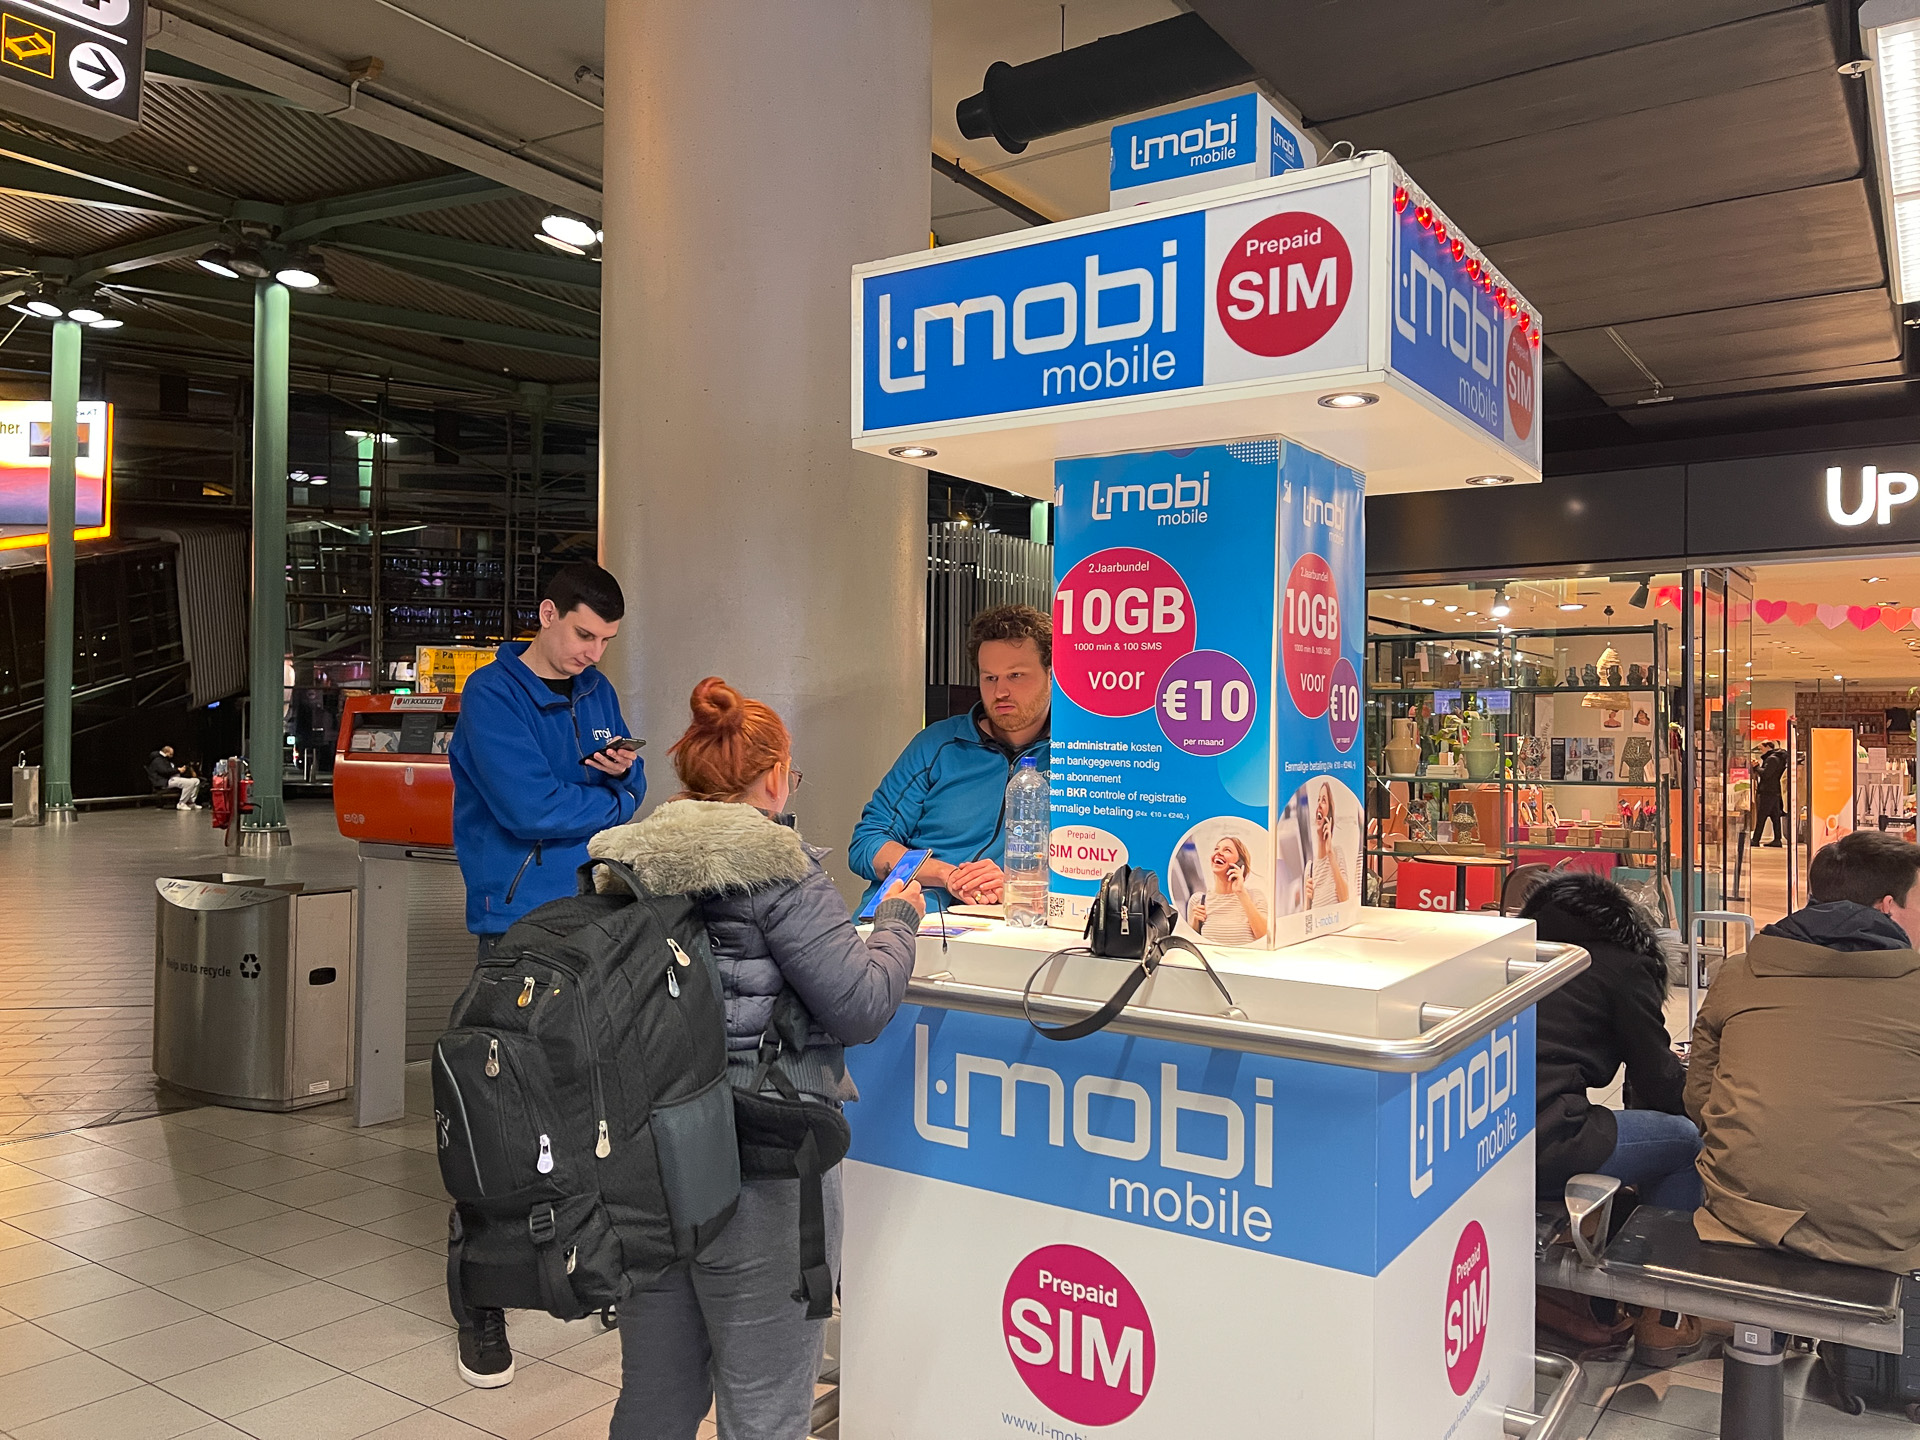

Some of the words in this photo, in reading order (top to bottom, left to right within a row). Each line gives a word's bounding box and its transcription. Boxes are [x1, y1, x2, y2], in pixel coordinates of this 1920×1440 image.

[1190, 147, 1236, 167] mobile
[1245, 227, 1322, 257] Prepaid
[1226, 257, 1338, 322] SIM
[1043, 343, 1176, 397] mobile
[1508, 360, 1532, 413] SIM
[1459, 376, 1498, 427] mobile
[1157, 509, 1208, 527] mobile
[1056, 586, 1186, 635] 10GB
[1286, 588, 1338, 641] 10GB
[443, 651, 477, 660] Parking
[1074, 642, 1095, 651] 1000
[1096, 642, 1112, 651] min
[1114, 642, 1120, 651] &
[1123, 642, 1138, 651] 100
[1140, 641, 1162, 651] SMS
[1088, 670, 1145, 690] voor
[1300, 673, 1326, 692] voor
[1162, 679, 1250, 722] €10
[1330, 684, 1358, 722] €10
[1750, 720, 1776, 731] Sale
[1067, 740, 1129, 751] administratie
[1131, 742, 1162, 752] kosten
[1183, 739, 1196, 748] per
[1197, 738, 1224, 747] maand
[1067, 756, 1131, 769] bankgegevens
[1133, 758, 1160, 771] nodig
[1284, 761, 1309, 773] Eenmalige
[1310, 761, 1327, 773] betaling
[1066, 772, 1122, 783] abonnement
[1066, 788, 1088, 798] BKR
[1089, 790, 1126, 800] controle
[1128, 791, 1137, 801] of
[1139, 792, 1187, 804] registratie
[1050, 803, 1091, 816] enmalige
[1093, 804, 1134, 819] betaling
[1067, 830, 1096, 840] Prepaid
[1049, 843, 1073, 859] SIM
[1077, 846, 1118, 862] ONLY
[1060, 865, 1103, 877] Jaarbundel
[180, 963, 189, 973] us
[190, 963, 198, 974] to
[200, 965, 231, 979] recycle
[1477, 1106, 1518, 1173] mobile
[1109, 1176, 1273, 1243] mobile
[1456, 1242, 1481, 1285] Prepaid
[1038, 1269, 1118, 1308] Prepaid
[1446, 1266, 1488, 1369] SIM
[1008, 1297, 1144, 1396] SIM
